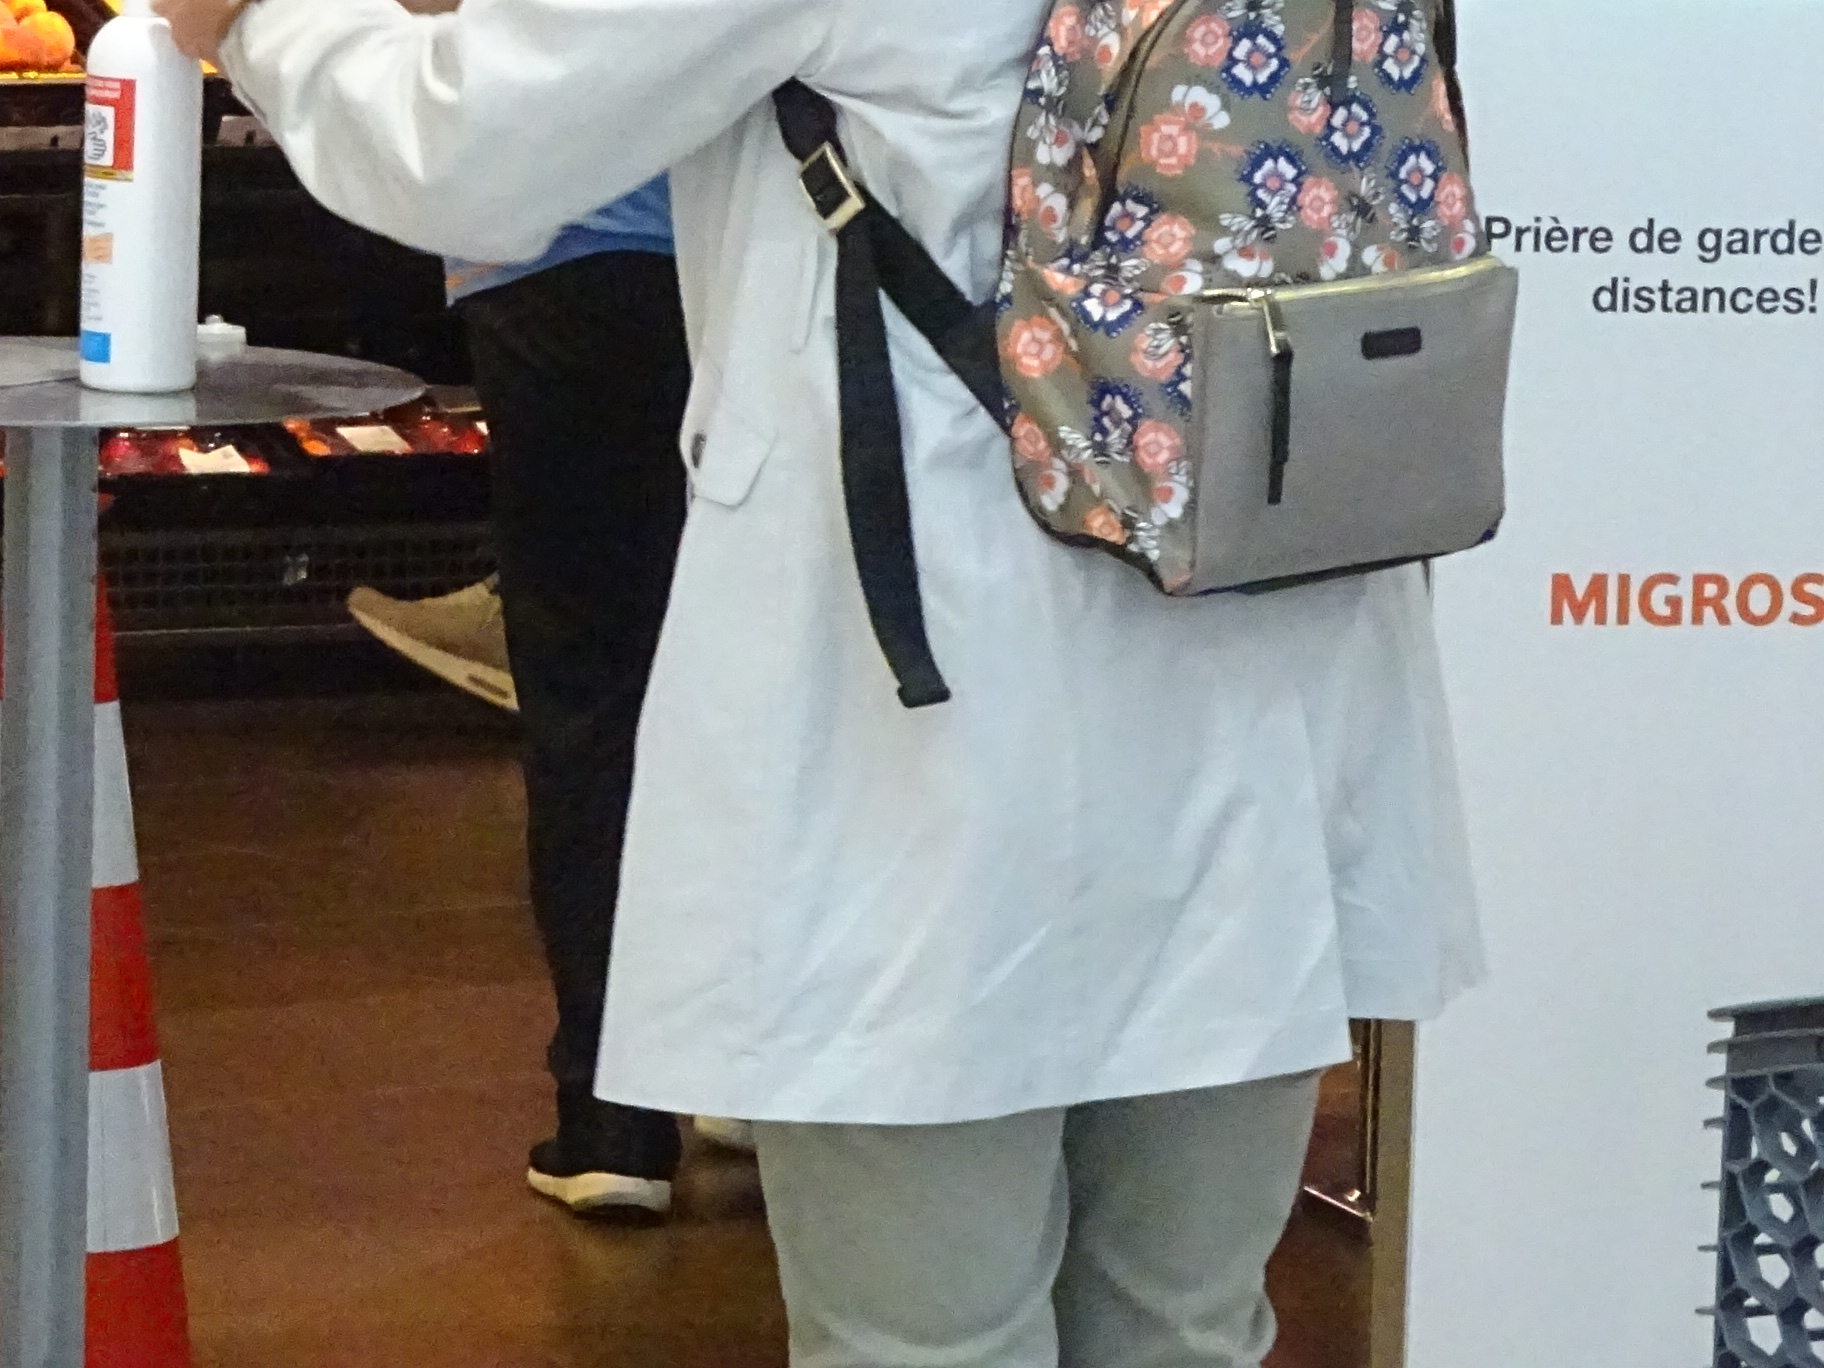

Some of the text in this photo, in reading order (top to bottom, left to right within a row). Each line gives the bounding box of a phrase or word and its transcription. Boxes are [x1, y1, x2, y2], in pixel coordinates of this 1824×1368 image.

[1484, 215, 1823, 264] Prière de garde
[1592, 276, 1819, 314] distances!
[1549, 571, 1824, 627] MIGROS
